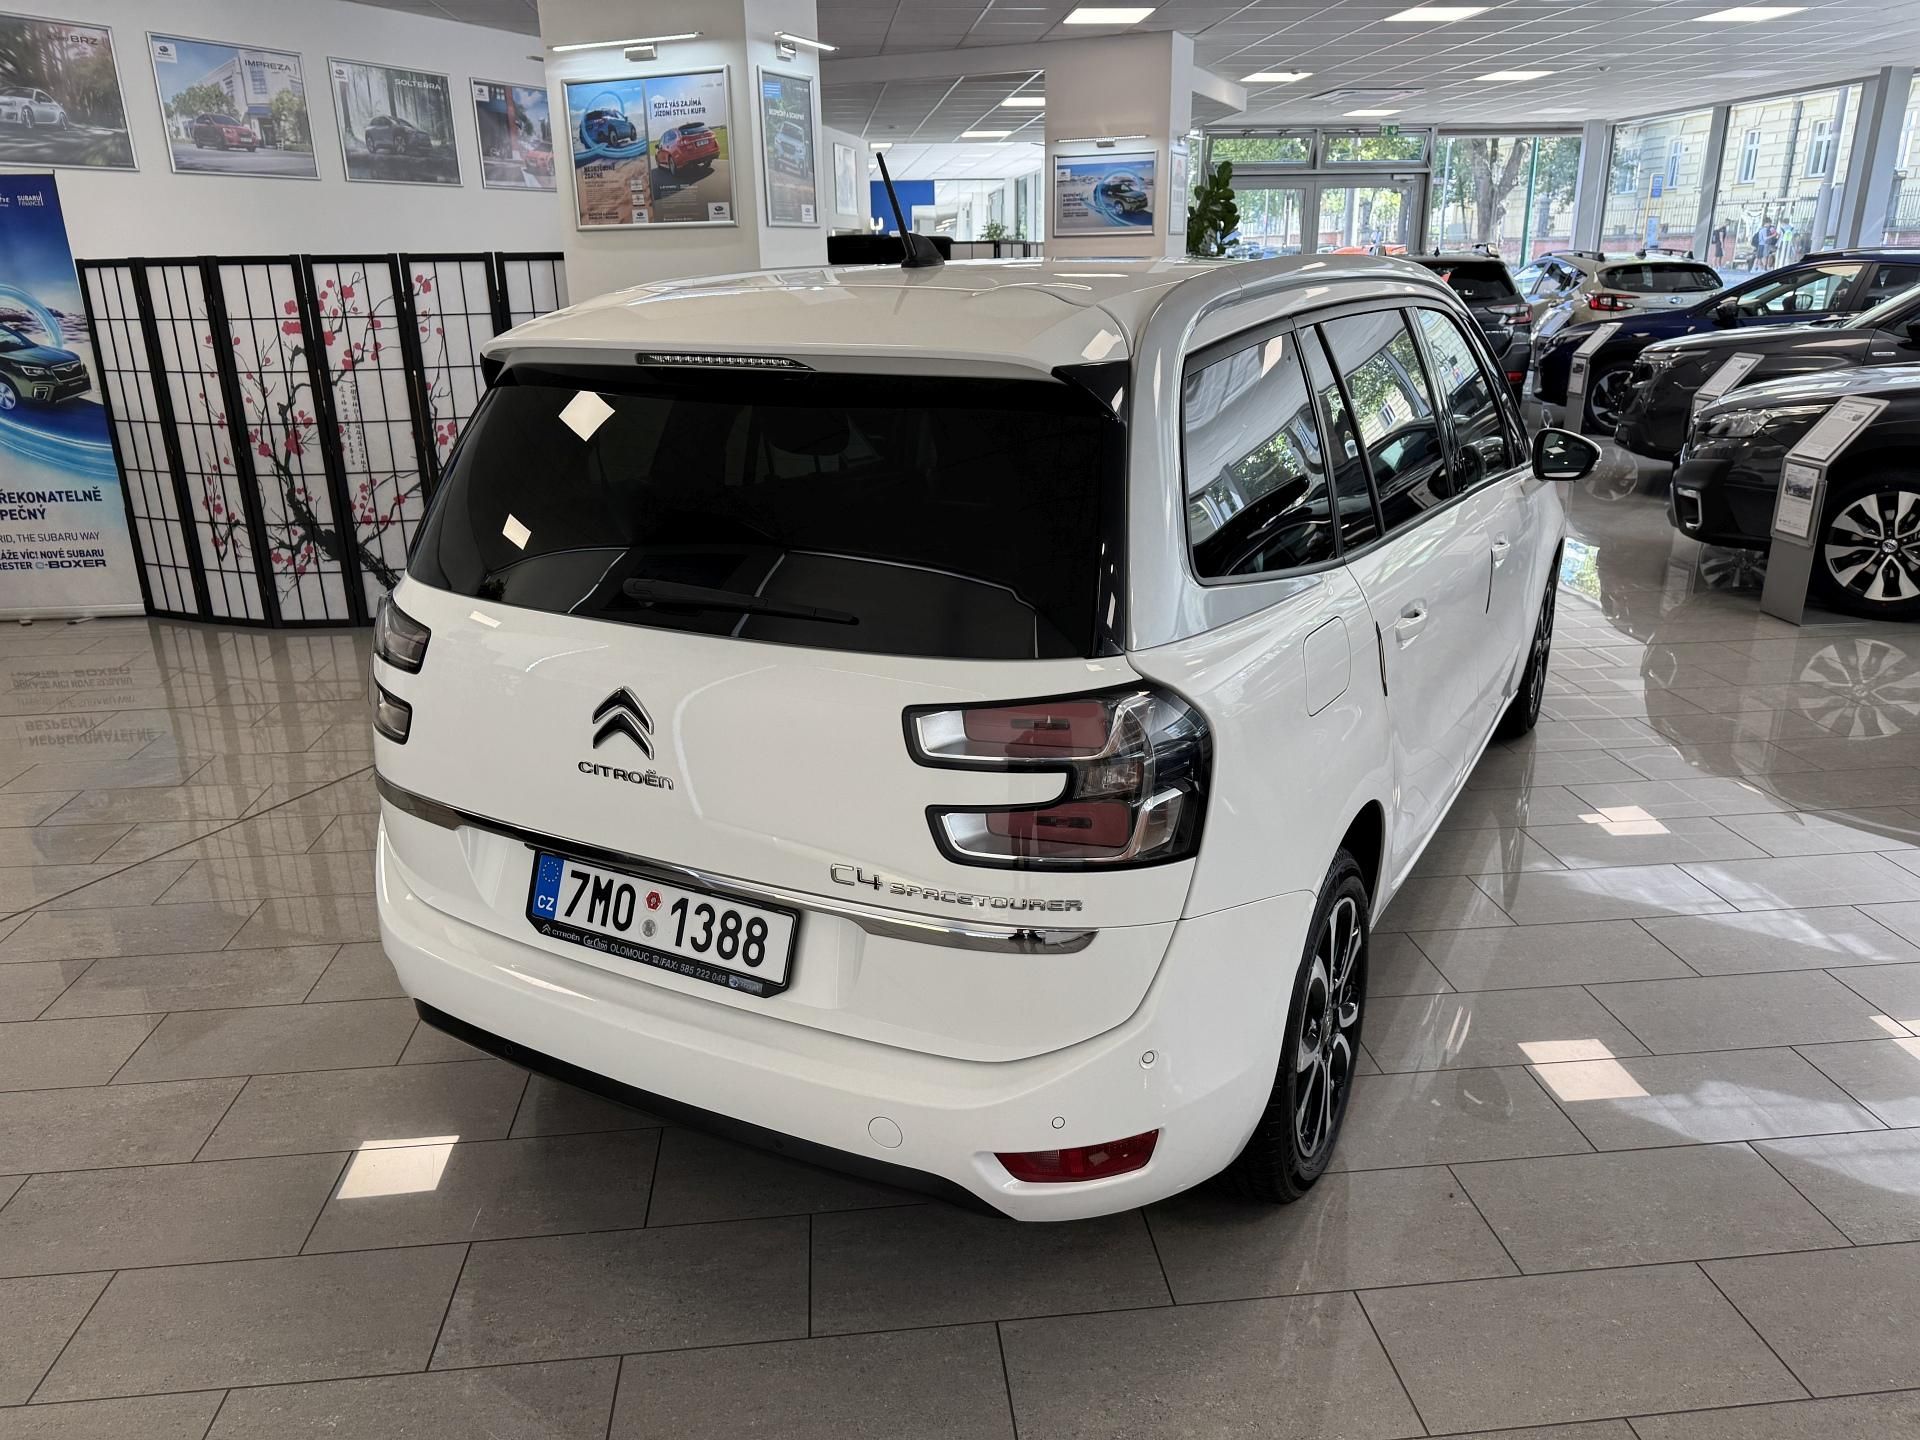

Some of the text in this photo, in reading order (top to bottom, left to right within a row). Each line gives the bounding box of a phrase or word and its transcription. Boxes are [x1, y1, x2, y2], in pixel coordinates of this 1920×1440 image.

[70, 35, 98, 45] BRZ
[244, 59, 292, 71] IMPREZA
[394, 78, 442, 91] SOLTERRA
[16, 533, 36, 543] THE
[38, 532, 78, 542] SUBARU
[80, 531, 99, 541] WAY
[40, 547, 65, 559] NOVÉ
[66, 548, 105, 558] SUBARU
[577, 760, 675, 791] CITROËN
[830, 862, 1083, 912] C4 SPACETOURER
[537, 894, 555, 912] CZ
[670, 897, 768, 968] 1388
[609, 943, 650, 961] OLOMOUC
[680, 963, 694, 975] 585
[696, 967, 710, 979] 222
[711, 972, 727, 984] 048
